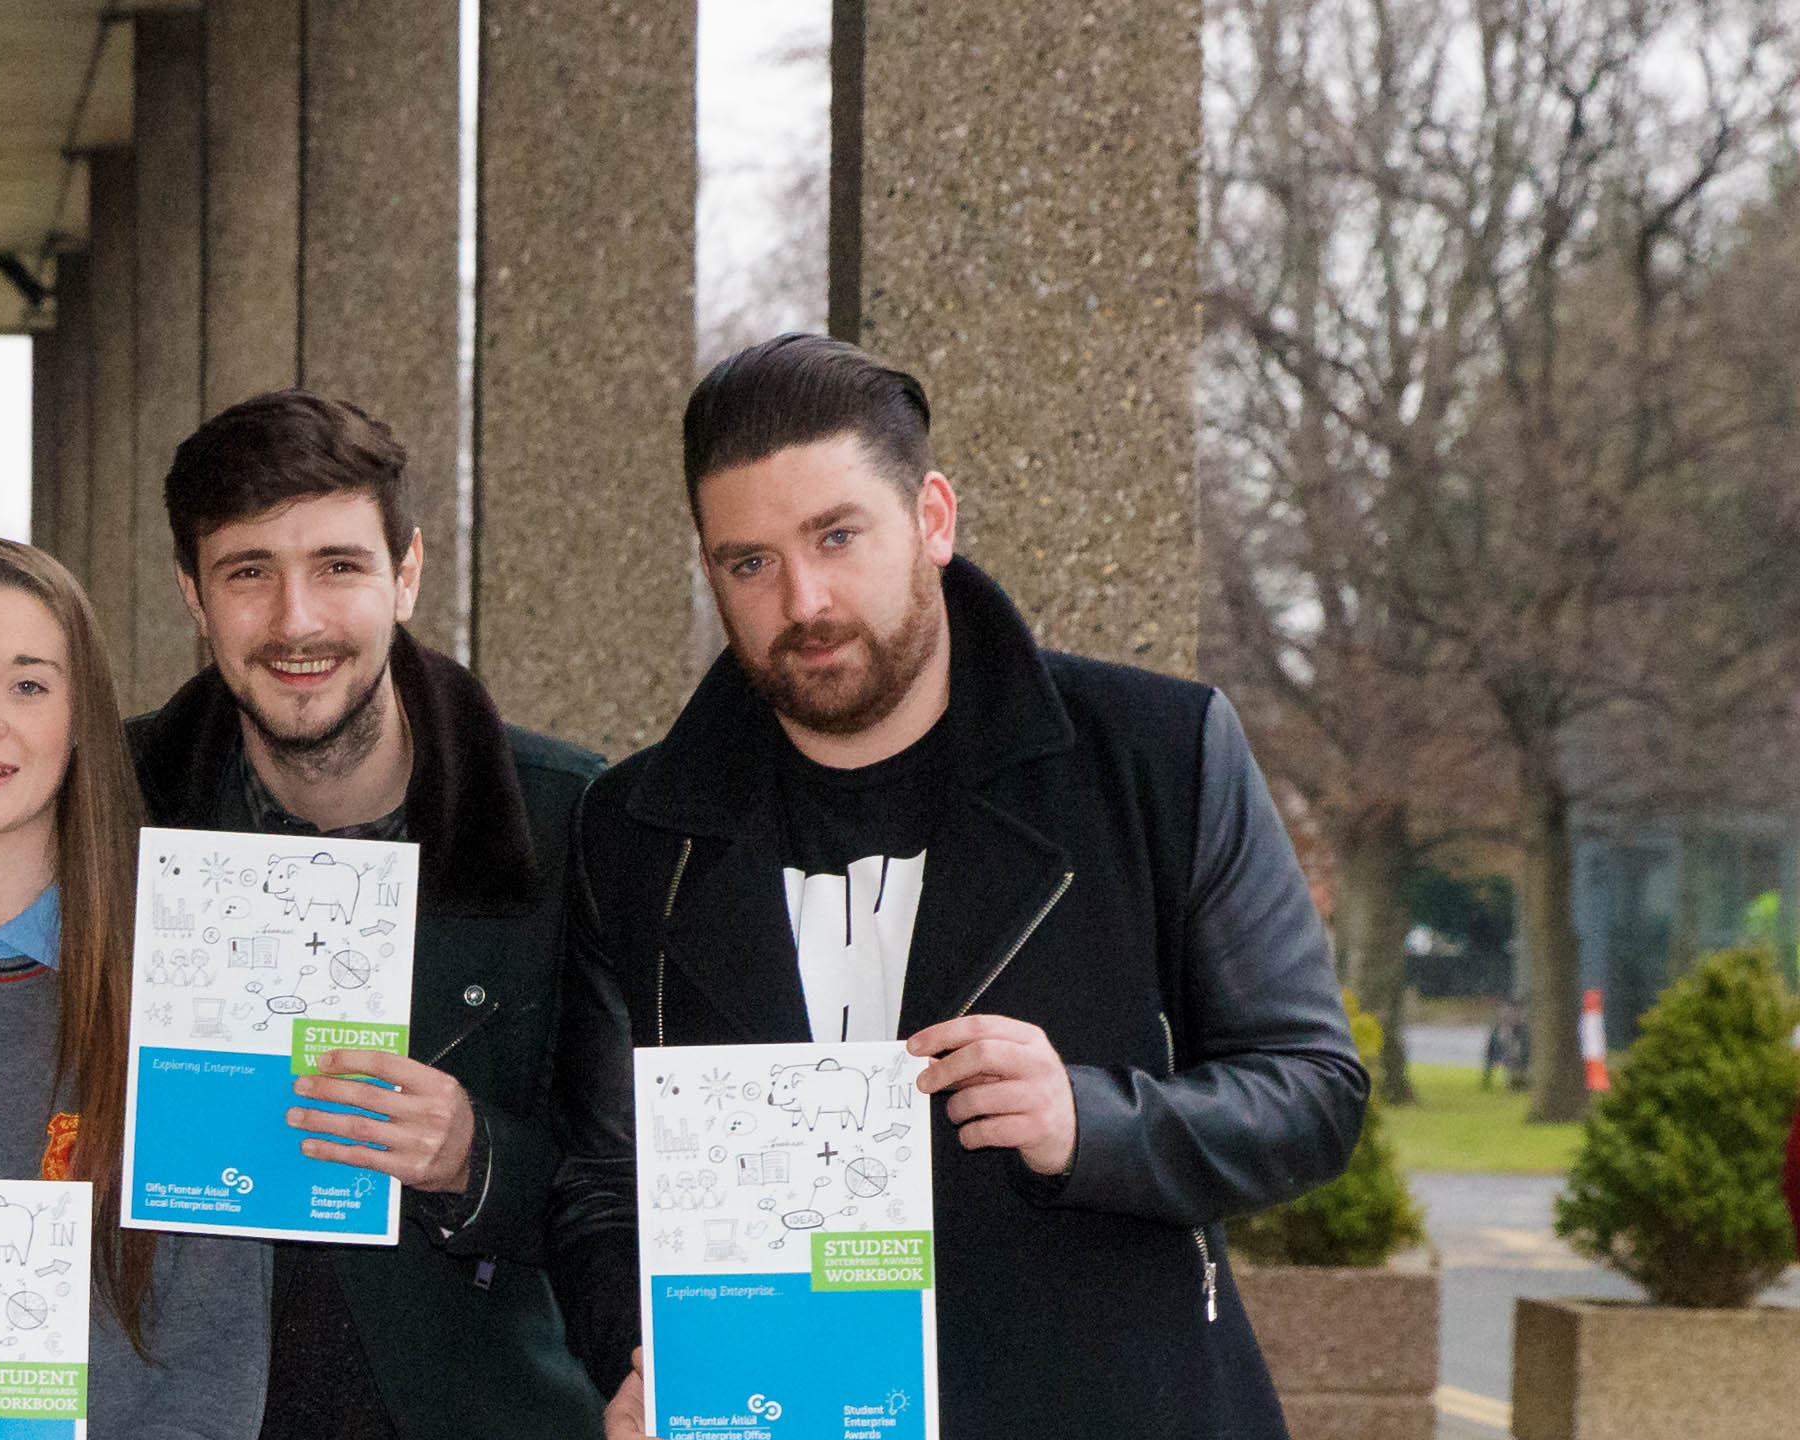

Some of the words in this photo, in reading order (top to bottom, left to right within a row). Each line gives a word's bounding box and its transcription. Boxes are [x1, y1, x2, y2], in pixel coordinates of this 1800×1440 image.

[274, 1000, 303, 1010] IDEAS
[305, 1026, 400, 1047] STUDENT
[152, 1058, 200, 1075] Exploring
[311, 1185, 350, 1197] Student
[145, 1197, 169, 1208] Local
[170, 1199, 214, 1211] Enterprise
[215, 1202, 242, 1213] Office
[311, 1196, 361, 1209] Enterprise
[310, 1209, 346, 1220] Awards
[789, 1214, 821, 1225] IDEAS
[824, 1239, 924, 1257] STUDENT
[824, 1257, 880, 1267] ENTERPRISE
[882, 1256, 924, 1266] AWARDS
[824, 1267, 924, 1283] WORKBOOK
[666, 1286, 717, 1301] Exploring
[843, 1405, 884, 1415] Student
[693, 1415, 729, 1426] Fiontair
[843, 1417, 897, 1428] Enterprise
[743, 1430, 772, 1440] Office
[843, 1430, 882, 1440] Awards
